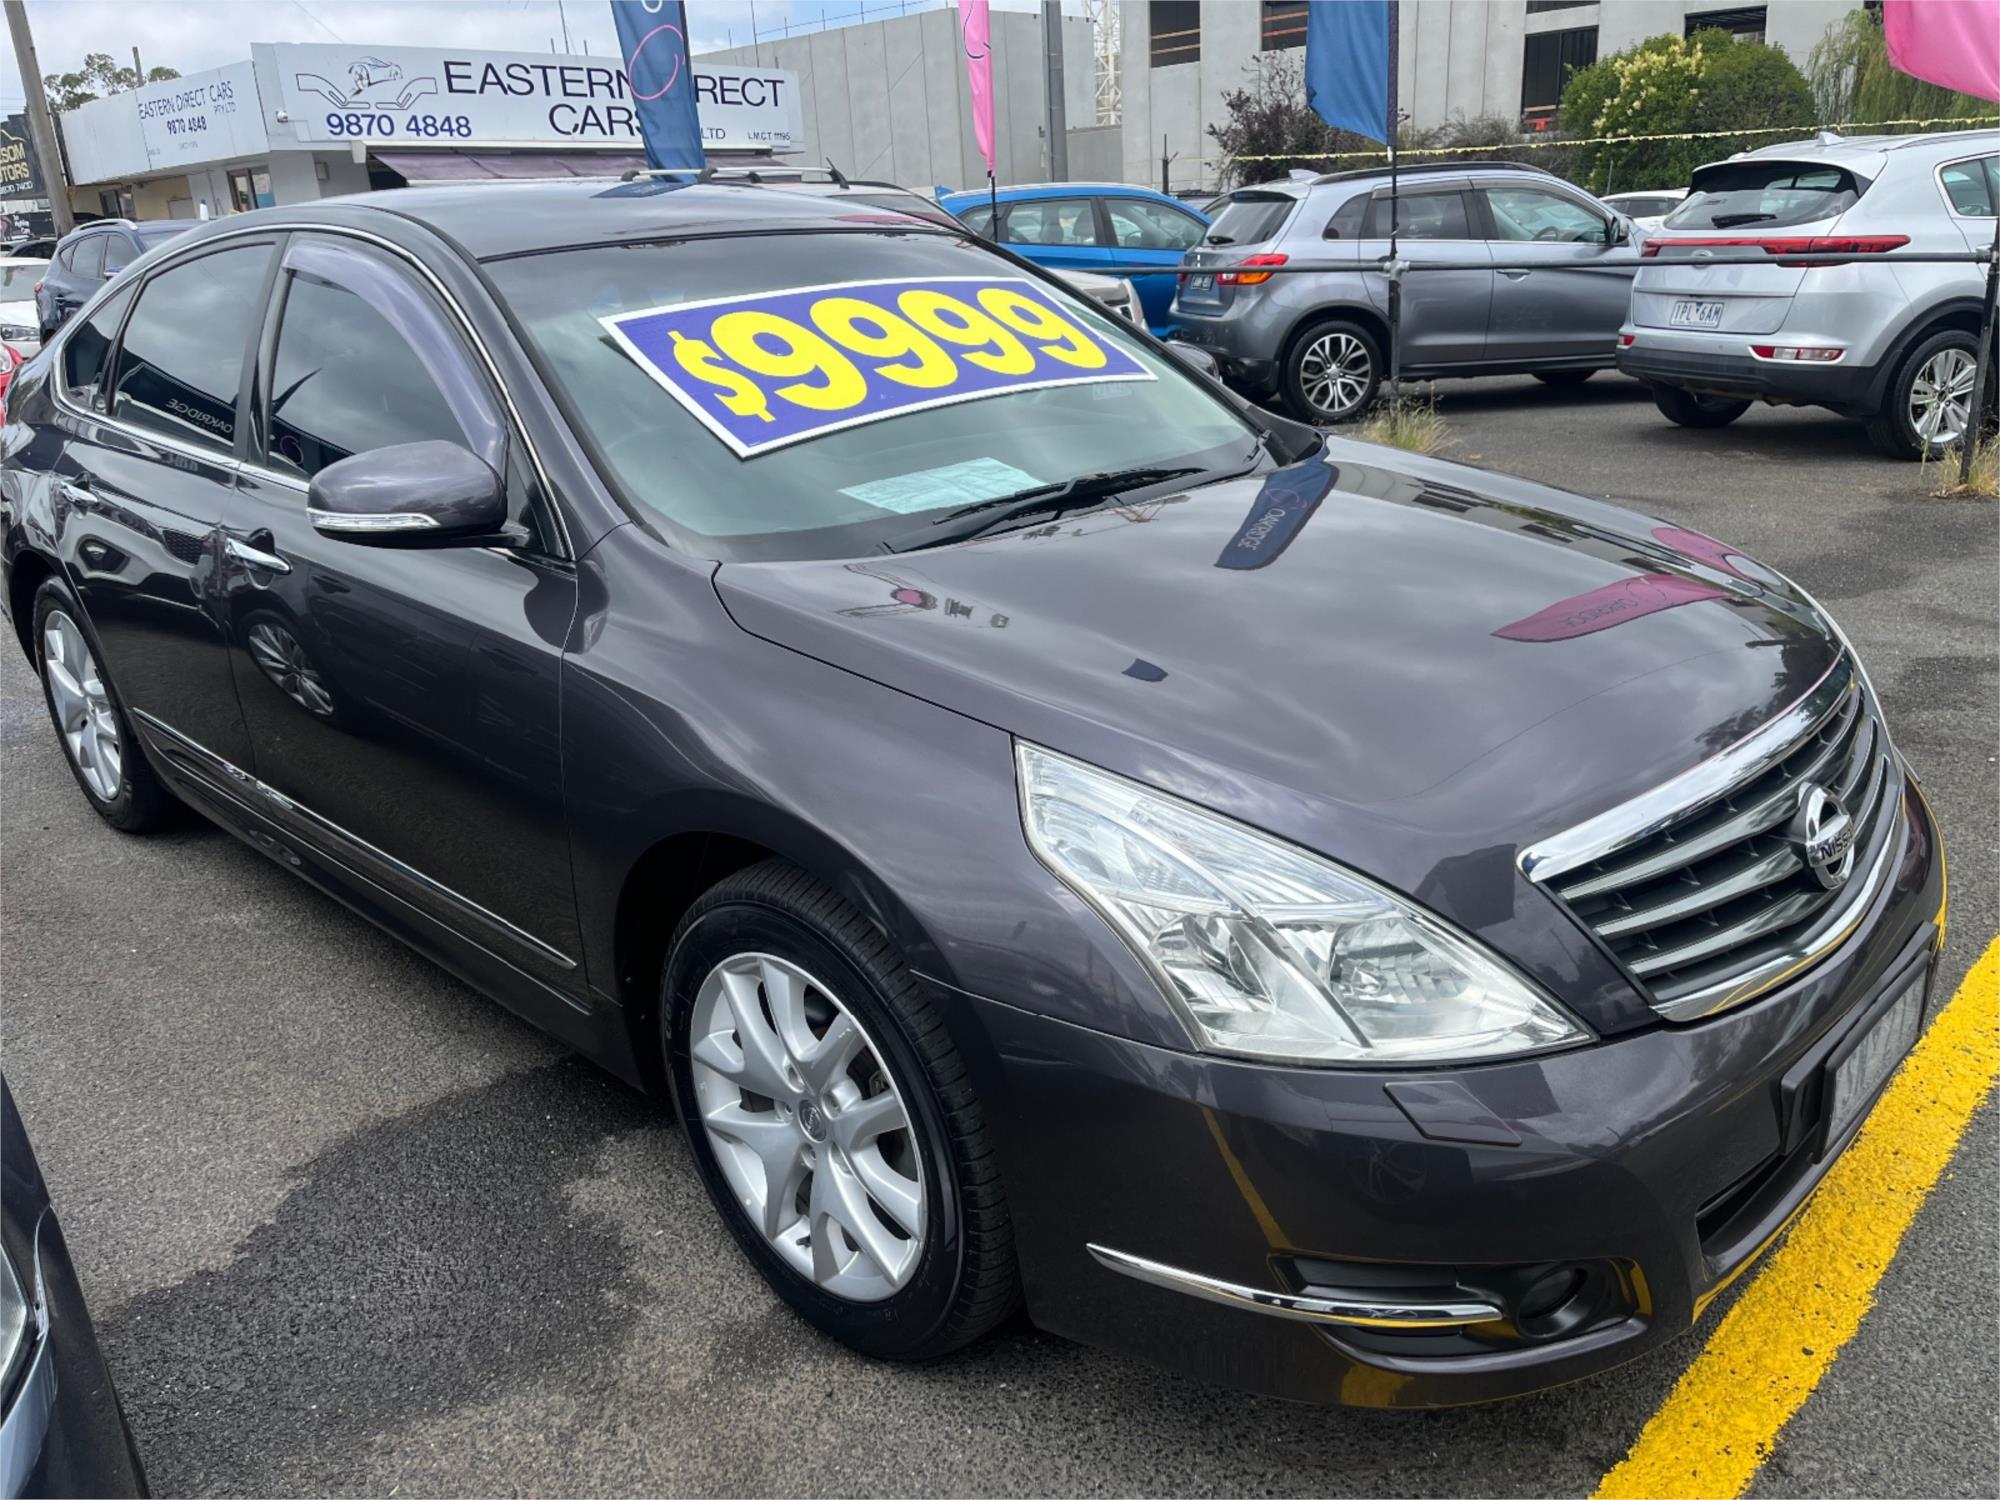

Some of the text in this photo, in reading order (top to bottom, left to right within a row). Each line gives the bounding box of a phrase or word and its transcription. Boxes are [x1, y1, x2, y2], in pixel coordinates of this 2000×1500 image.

[444, 60, 785, 107] EASTERN RECT
[138, 80, 233, 119] EASTERN DIRECT CARS
[166, 116, 207, 135] 9870 4848
[326, 113, 472, 137] 9870 4848
[701, 127, 726, 140] LTD
[0, 142, 26, 164] SOM
[667, 287, 1108, 424] $9999
